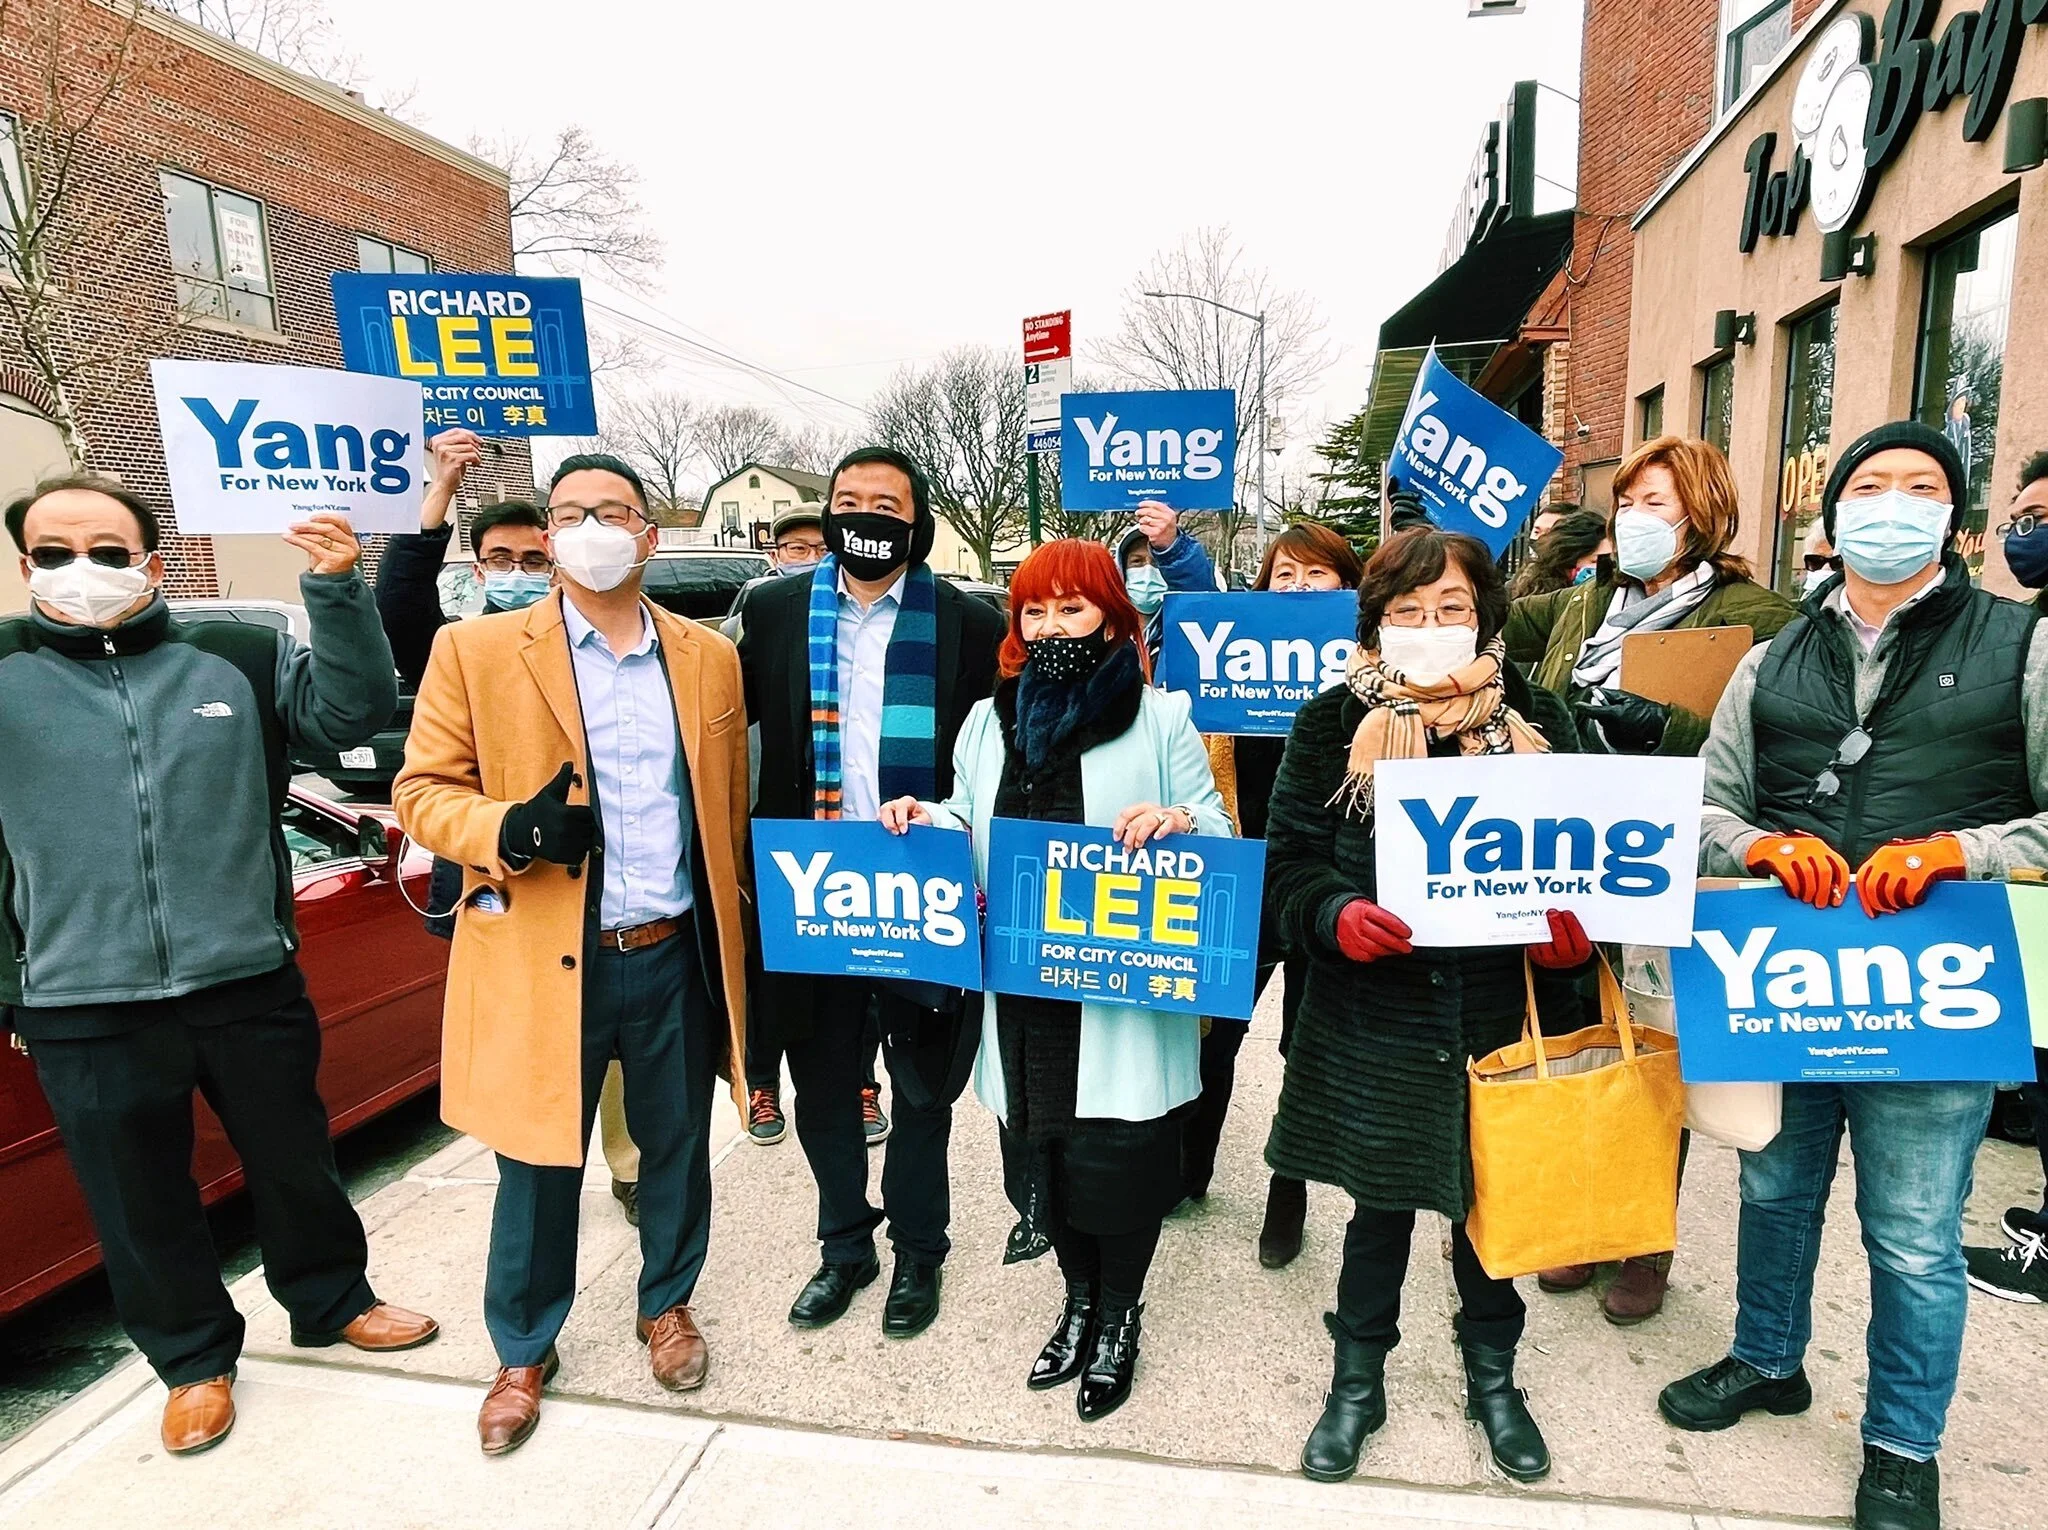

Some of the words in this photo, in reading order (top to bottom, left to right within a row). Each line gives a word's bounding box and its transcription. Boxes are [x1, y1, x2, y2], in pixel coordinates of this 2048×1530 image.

[1739, 132, 1811, 253] Top
[1863, 0, 2048, 168] Bag
[226, 229, 254, 247] RENT
[388, 289, 532, 317] RICHARD
[1024, 321, 1034, 331] NO
[1034, 315, 1064, 329] STANDING
[1025, 331, 1050, 343] Anytime
[391, 316, 540, 377] LEE
[1028, 365, 1037, 383] 2
[435, 386, 469, 400] CITY
[473, 386, 544, 401] COUNCIL
[424, 406, 462, 427] 차드
[466, 406, 486, 427] 이
[502, 404, 548, 427] 李真
[180, 396, 411, 495] Yang
[1072, 415, 1223, 481] Yang
[1402, 371, 1528, 529] Yang
[220, 473, 261, 491] For
[267, 474, 319, 491] New
[323, 475, 367, 493] York
[1089, 469, 1113, 482] For
[1115, 468, 1146, 481] New
[1148, 467, 1181, 480] York
[1405, 449, 1437, 479] New
[1438, 471, 1469, 505] York
[1782, 446, 1826, 513] OPE
[841, 527, 893, 560] Yang
[1178, 620, 1358, 694] Yang
[1199, 683, 1228, 699] For
[1231, 684, 1271, 700] New
[1273, 684, 1314, 701] York
[1047, 839, 1205, 880] RICHARD
[1398, 795, 1675, 897] Yang
[769, 851, 967, 947] Yang
[1427, 881, 1467, 900] For
[1474, 878, 1528, 897] New
[1533, 876, 1592, 895] York
[1044, 868, 1202, 947] LEE
[1496, 909, 1546, 919] YangforNY.
[795, 919, 829, 937] For
[832, 920, 876, 938] New
[878, 921, 921, 942] York
[1041, 943, 1076, 961] FOR
[1078, 948, 1117, 964] CITY
[1120, 950, 1198, 973] COUNCIL
[1040, 965, 1101, 990] 리차드
[1108, 972, 1128, 995] 이
[1148, 974, 1197, 1001] 李真
[1692, 926, 2001, 1030] Yang
[1728, 1013, 1774, 1034] For
[1780, 1012, 1843, 1033] New
[1844, 1009, 1916, 1032] York
[1807, 1046, 1889, 1058] YangforNY.com
